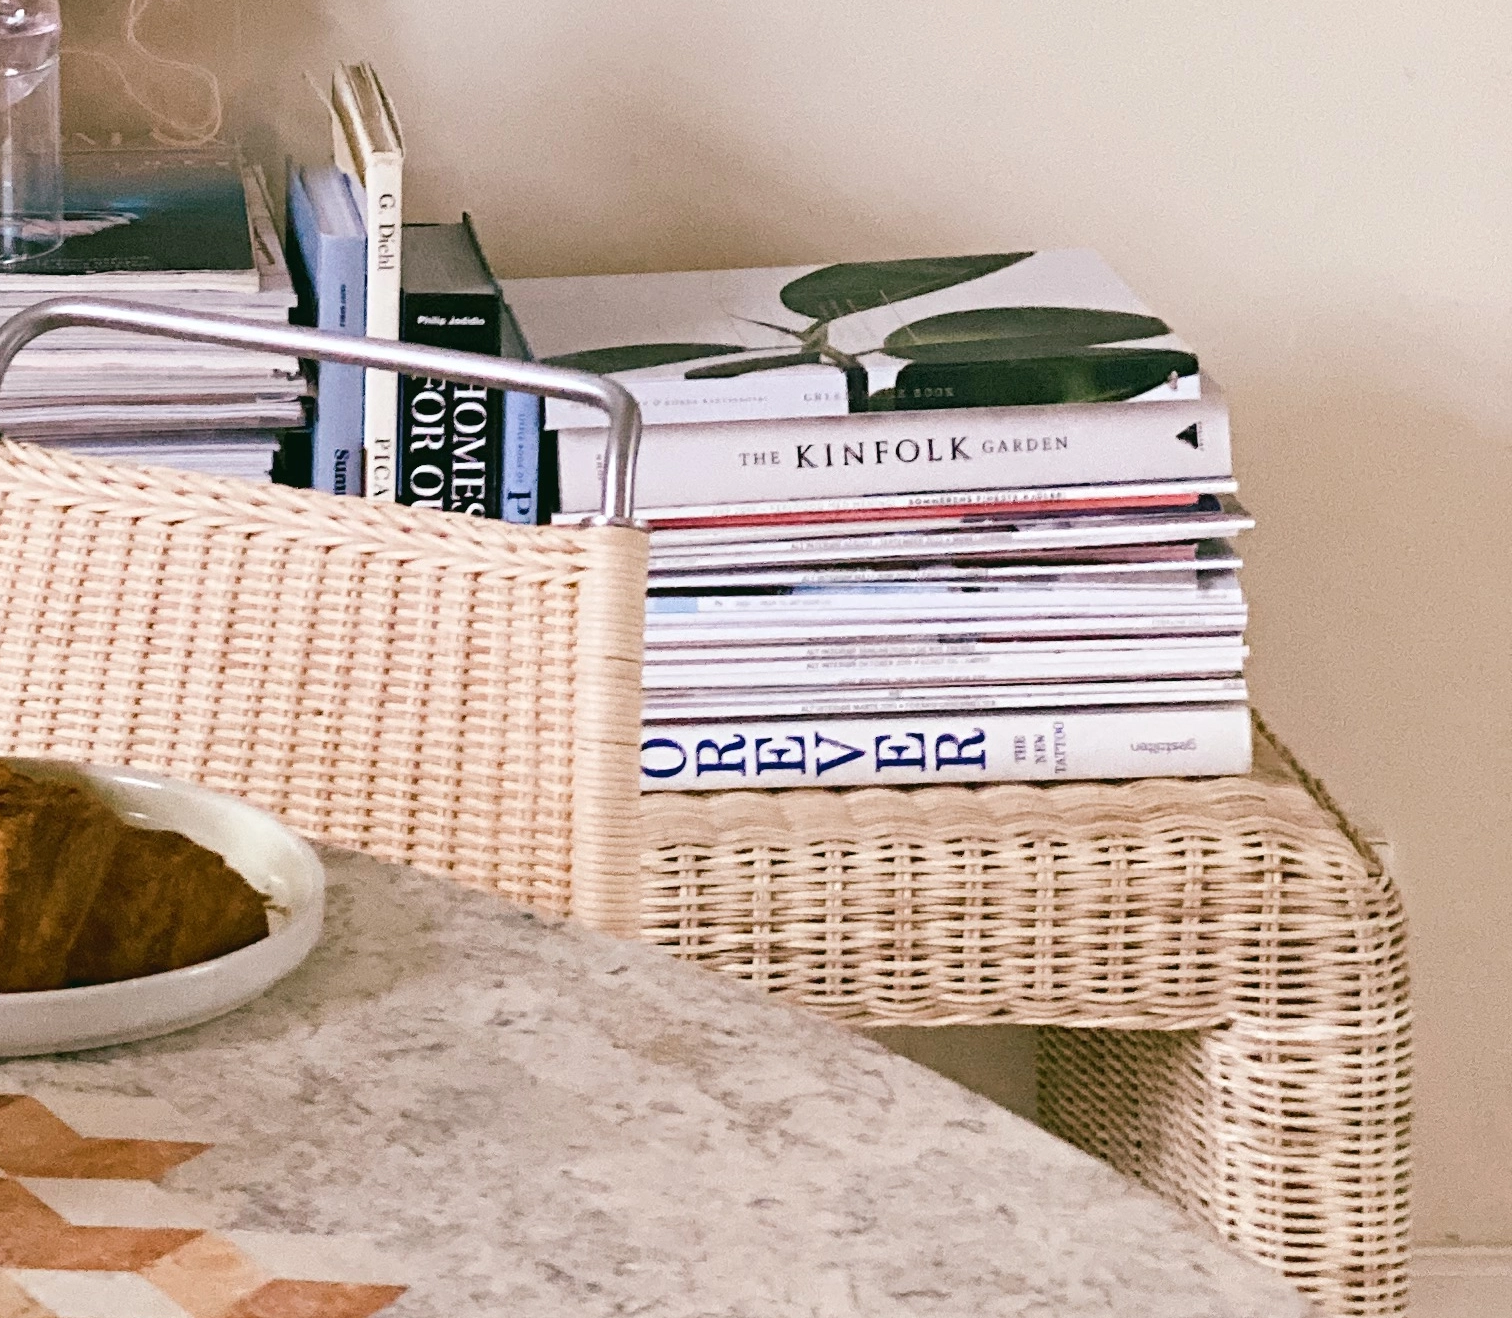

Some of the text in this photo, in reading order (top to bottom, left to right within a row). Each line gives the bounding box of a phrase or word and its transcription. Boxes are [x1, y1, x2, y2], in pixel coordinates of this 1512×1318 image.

[376, 223, 396, 272] Diehl
[738, 434, 1069, 470] THE KINFOLK GARDEN
[1013, 735, 1026, 763] THE
